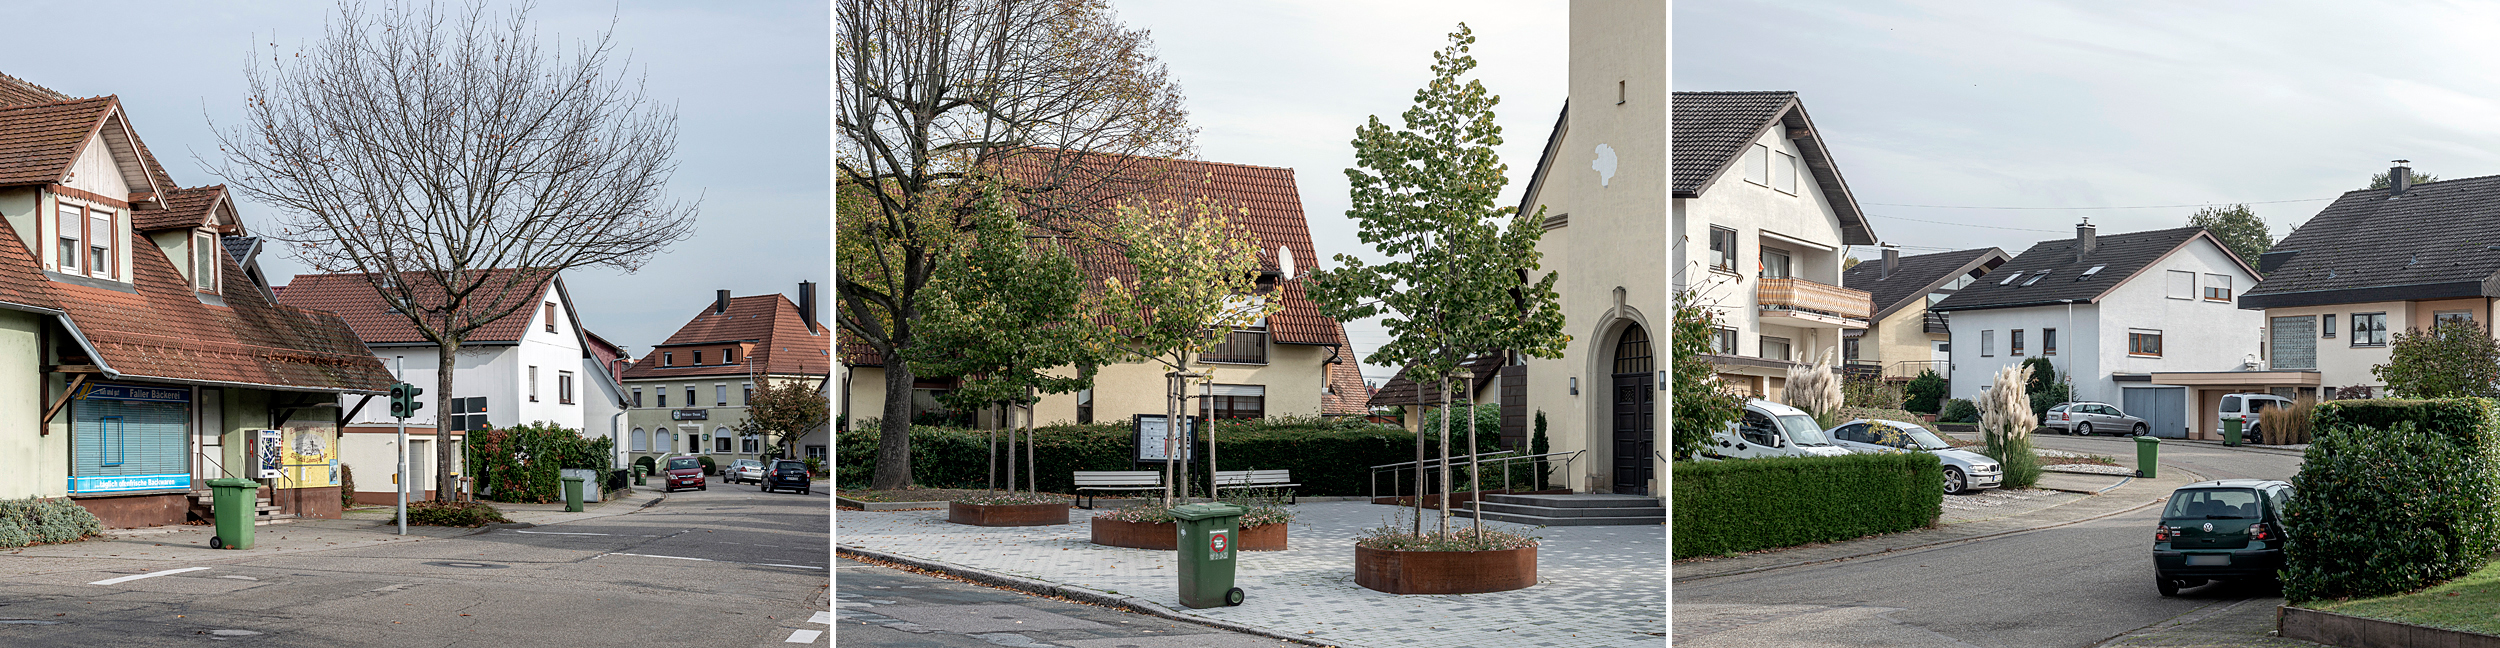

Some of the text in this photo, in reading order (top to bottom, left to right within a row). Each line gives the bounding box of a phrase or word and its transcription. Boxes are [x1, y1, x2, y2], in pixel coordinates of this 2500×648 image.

[129, 388, 180, 400] Faller Bäckerei
[118, 479, 147, 488] ofenfrische
[148, 478, 175, 487] Backwaren
